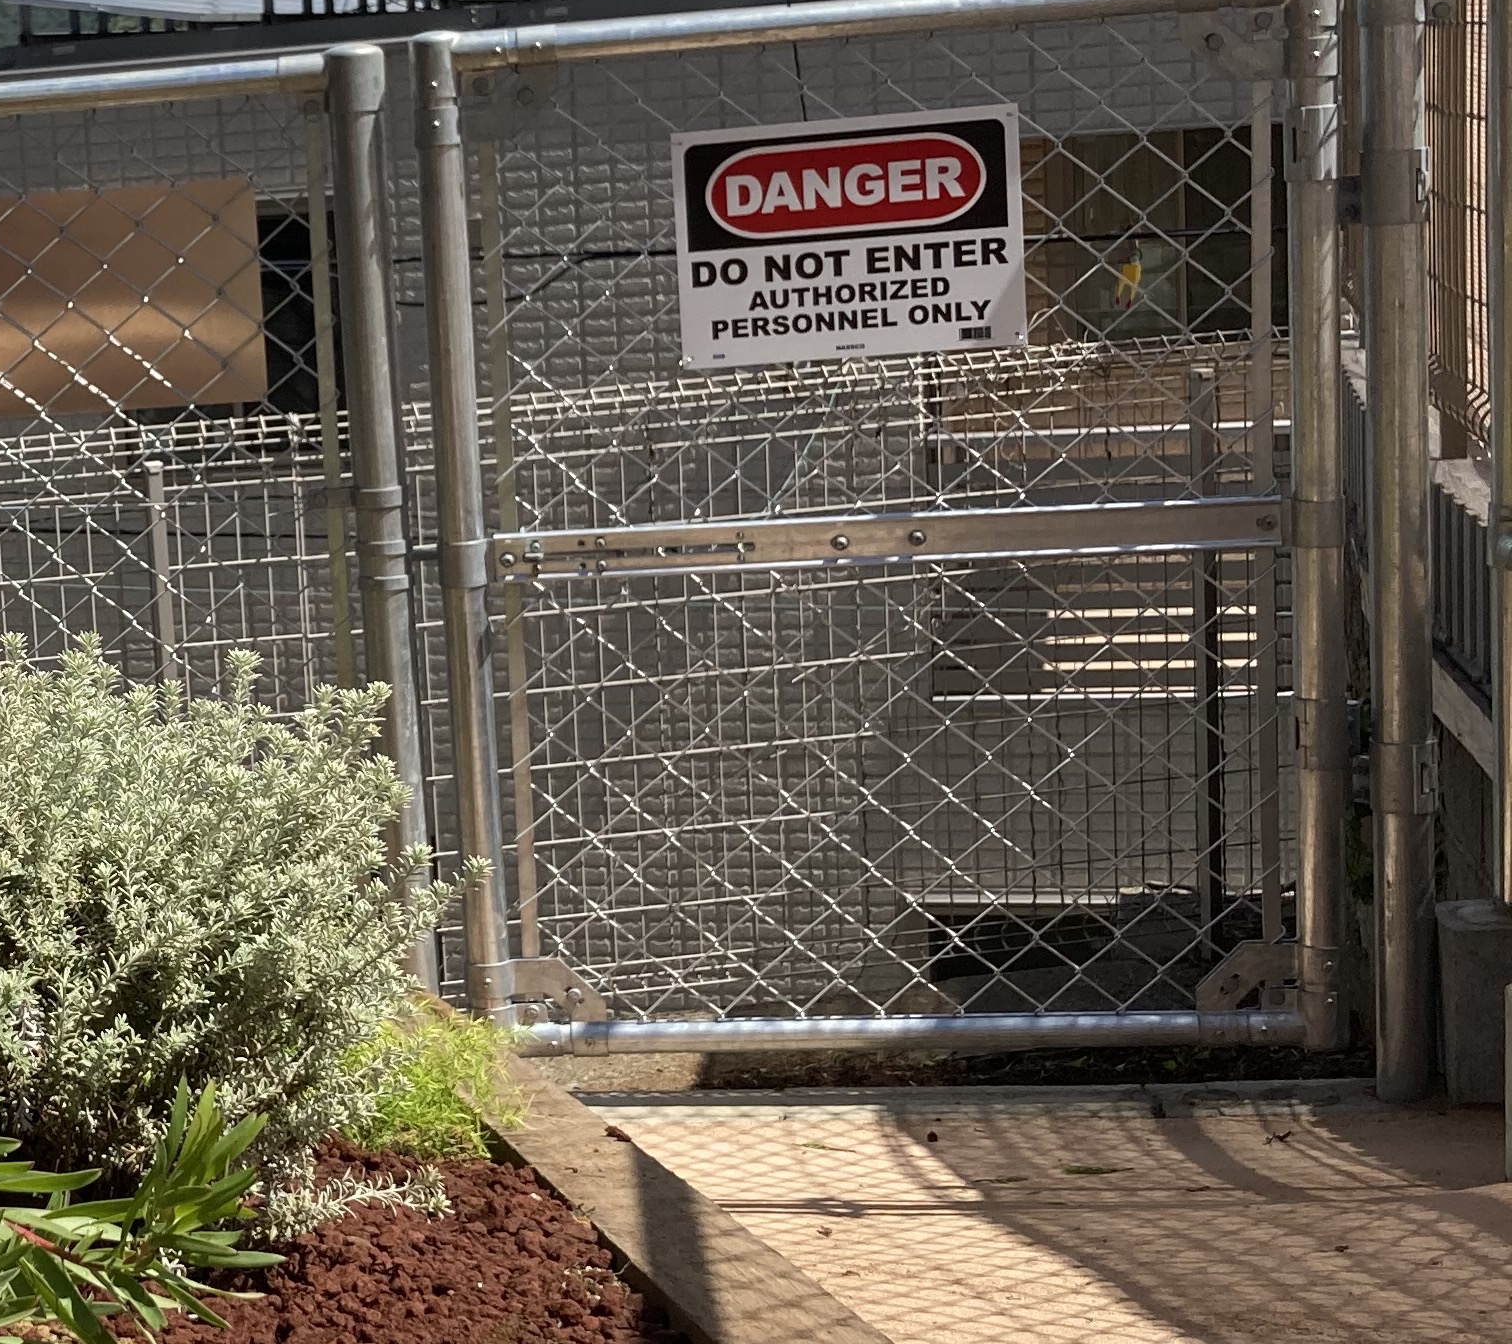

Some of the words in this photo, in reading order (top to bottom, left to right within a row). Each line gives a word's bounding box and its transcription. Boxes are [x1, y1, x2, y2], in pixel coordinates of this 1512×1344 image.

[725, 156, 966, 217] DANGER
[691, 258, 748, 288] DO
[764, 249, 850, 282] NOT
[866, 237, 1009, 274] ENTER
[748, 276, 950, 311] AUTHORIZED
[711, 308, 898, 340] PERSONNEL
[908, 299, 991, 325] ONLY
